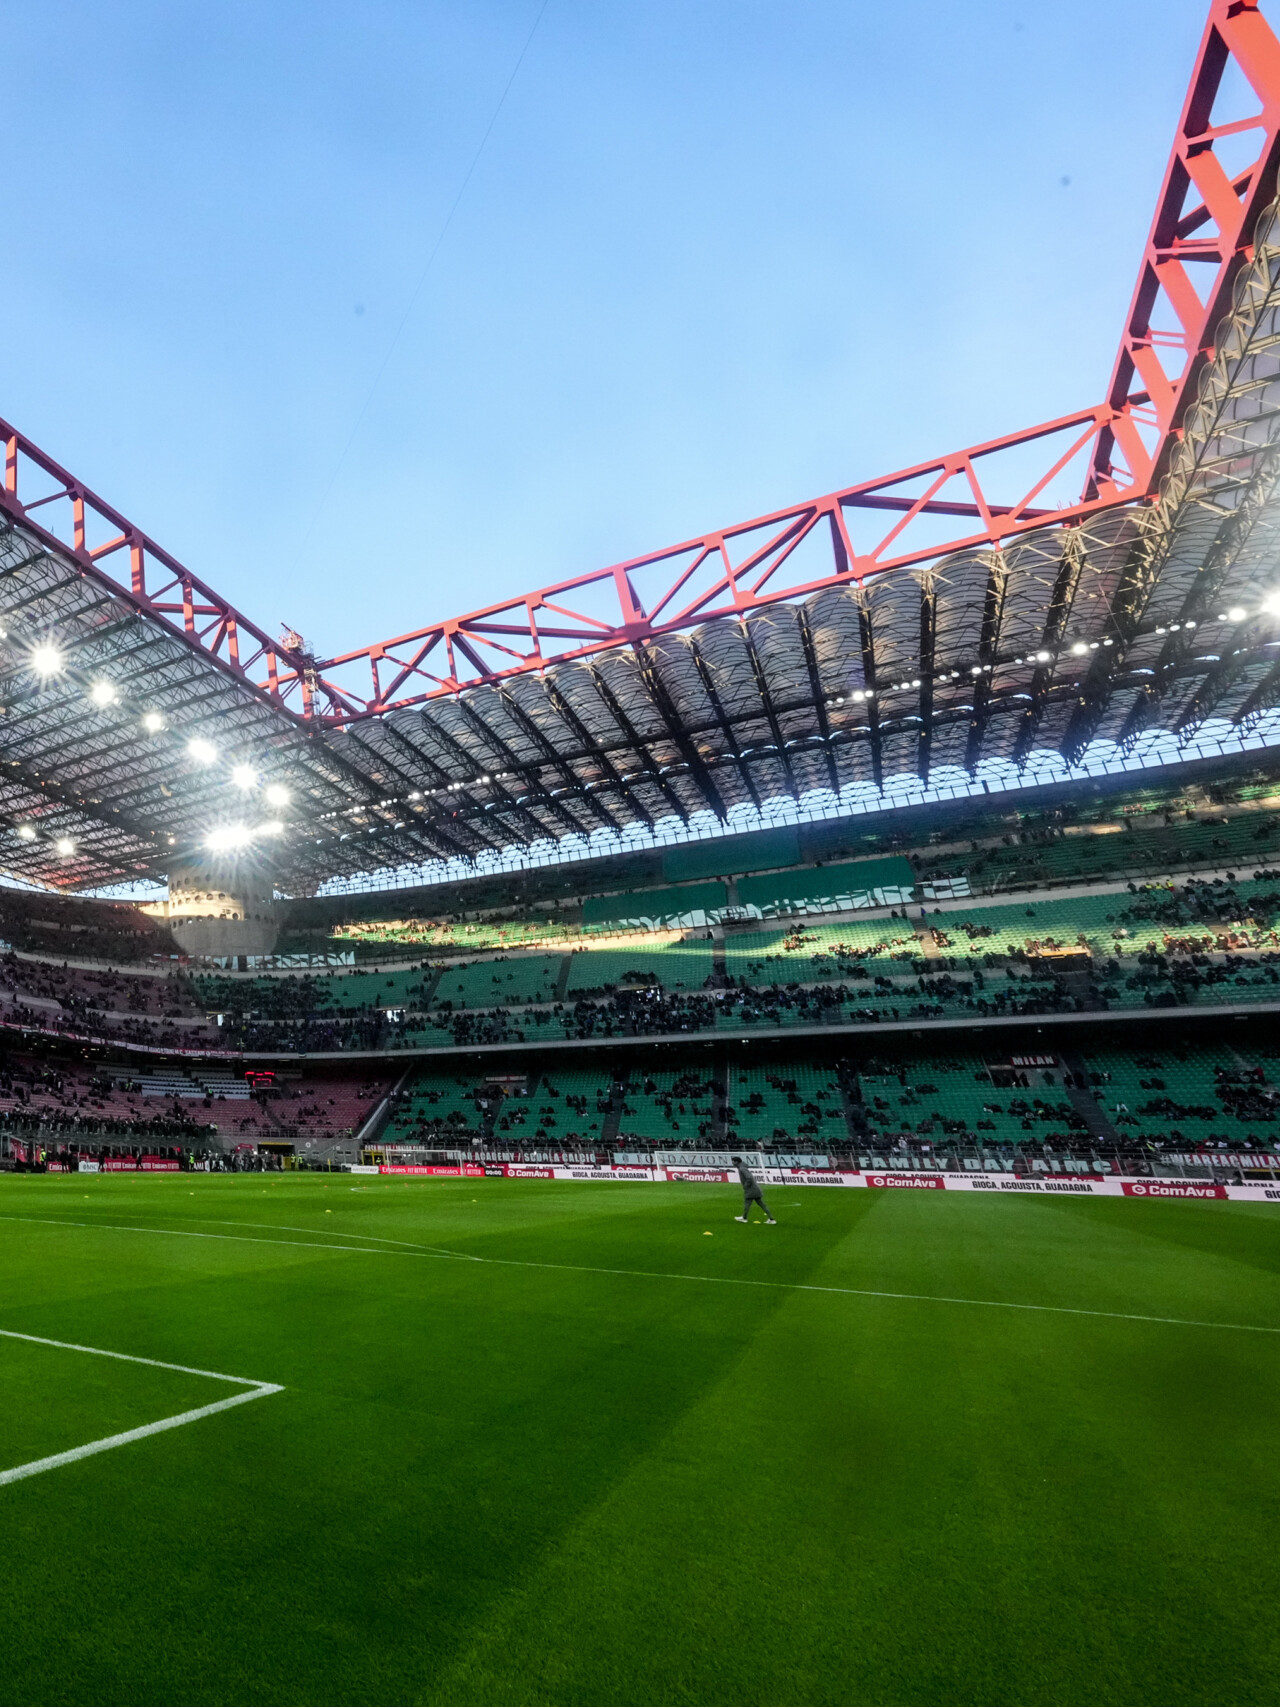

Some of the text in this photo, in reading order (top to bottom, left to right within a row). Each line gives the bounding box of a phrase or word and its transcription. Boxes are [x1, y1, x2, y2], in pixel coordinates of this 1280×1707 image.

[1012, 1056, 1055, 1066] MILAN
[474, 1152, 515, 1161] ACADEMY
[524, 1152, 560, 1162] SCUOLA
[562, 1153, 596, 1163] CALCIO
[858, 1156, 949, 1169] FAMILY
[963, 1158, 1015, 1171] DAY
[432, 1167, 459, 1175] Emirates
[807, 1176, 844, 1184] GUADAGNA
[886, 1178, 936, 1188] ComAve
[972, 1180, 1093, 1192] GIOCA, ACQUISTA, GUADAGNA
[1149, 1185, 1216, 1197] ComAve
